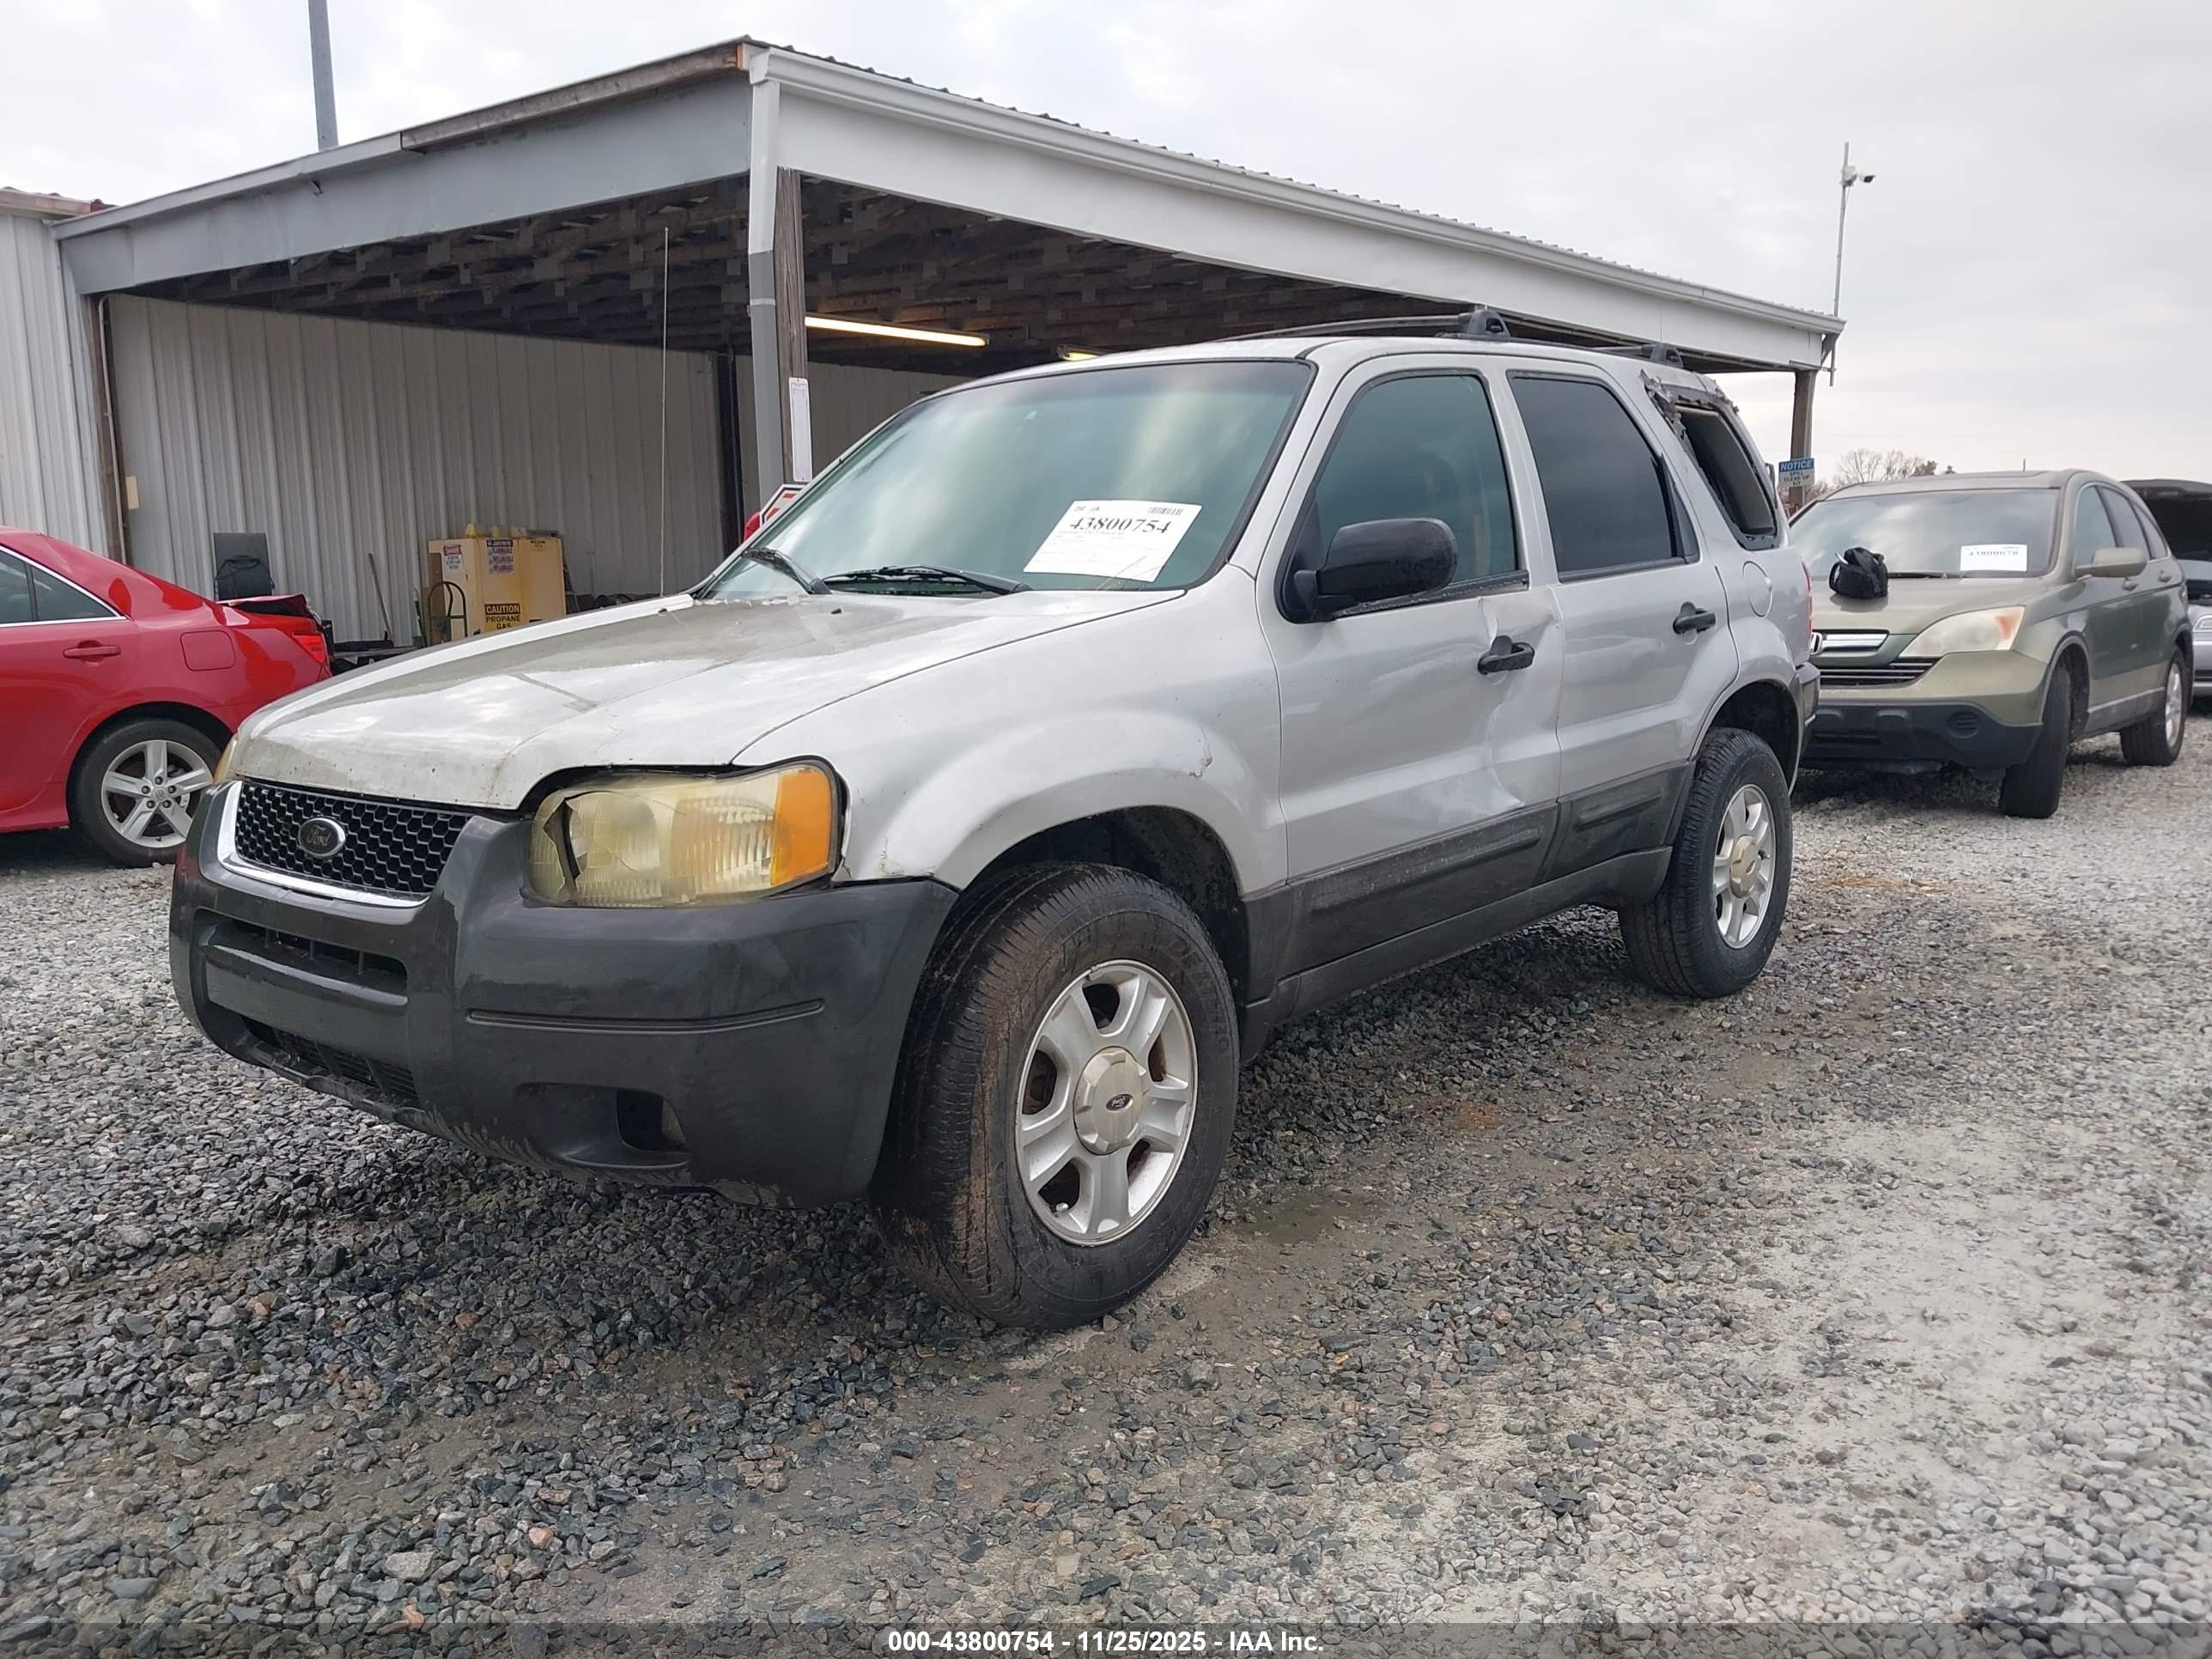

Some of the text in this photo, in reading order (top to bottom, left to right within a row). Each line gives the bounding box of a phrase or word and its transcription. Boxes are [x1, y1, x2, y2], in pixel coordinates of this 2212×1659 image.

[1780, 459, 1813, 471] NOTICE
[1070, 516, 1172, 534] 43800754
[485, 605, 520, 614] CAUTION
[307, 824, 331, 847] Ford
